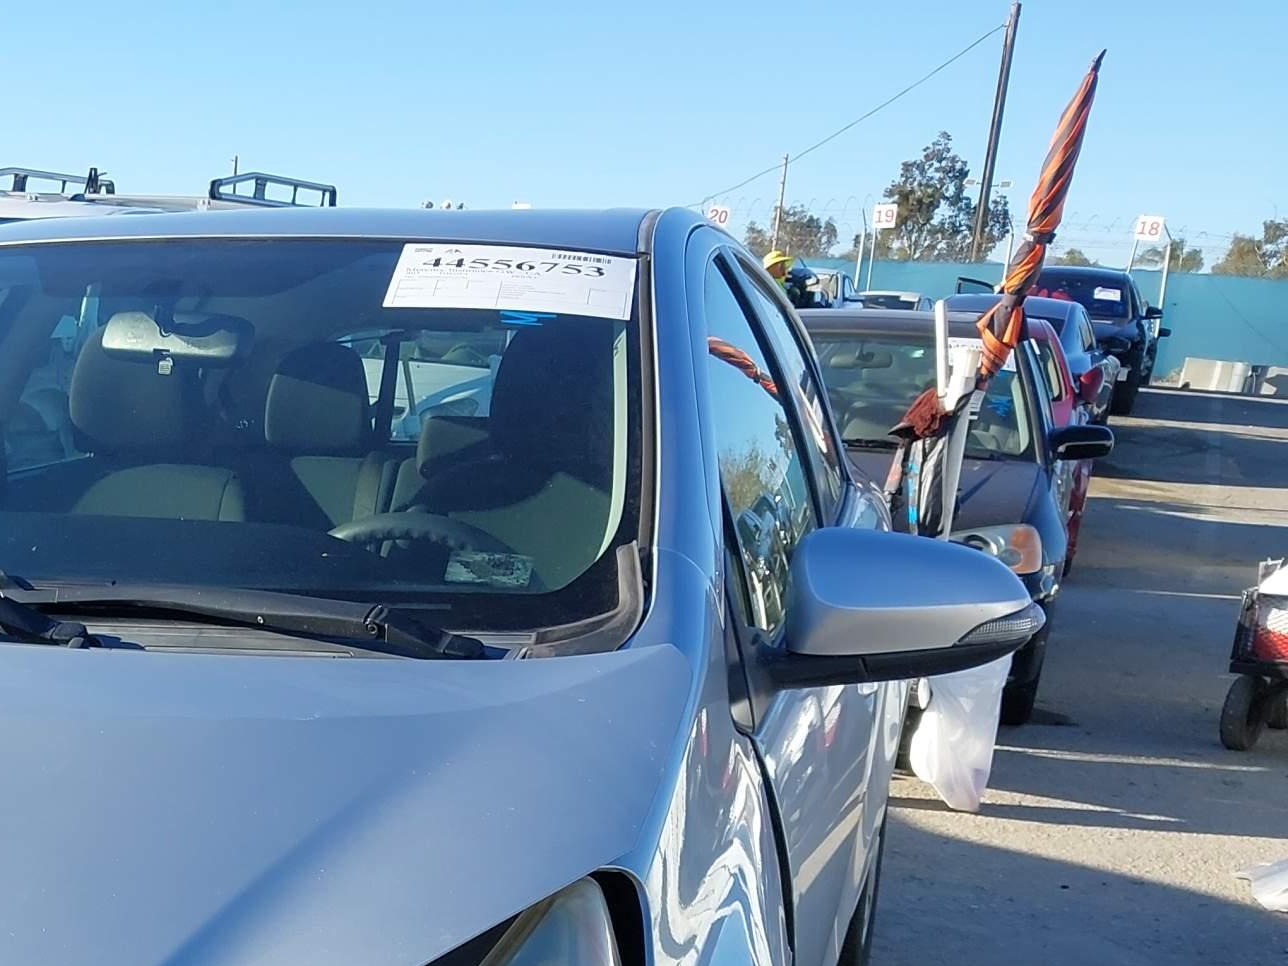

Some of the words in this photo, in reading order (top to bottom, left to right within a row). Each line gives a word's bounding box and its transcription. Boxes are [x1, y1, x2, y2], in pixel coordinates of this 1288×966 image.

[710, 208, 728, 224] 20
[874, 209, 894, 223] 19
[1136, 221, 1160, 236] 18
[422, 256, 606, 278] 44556753
